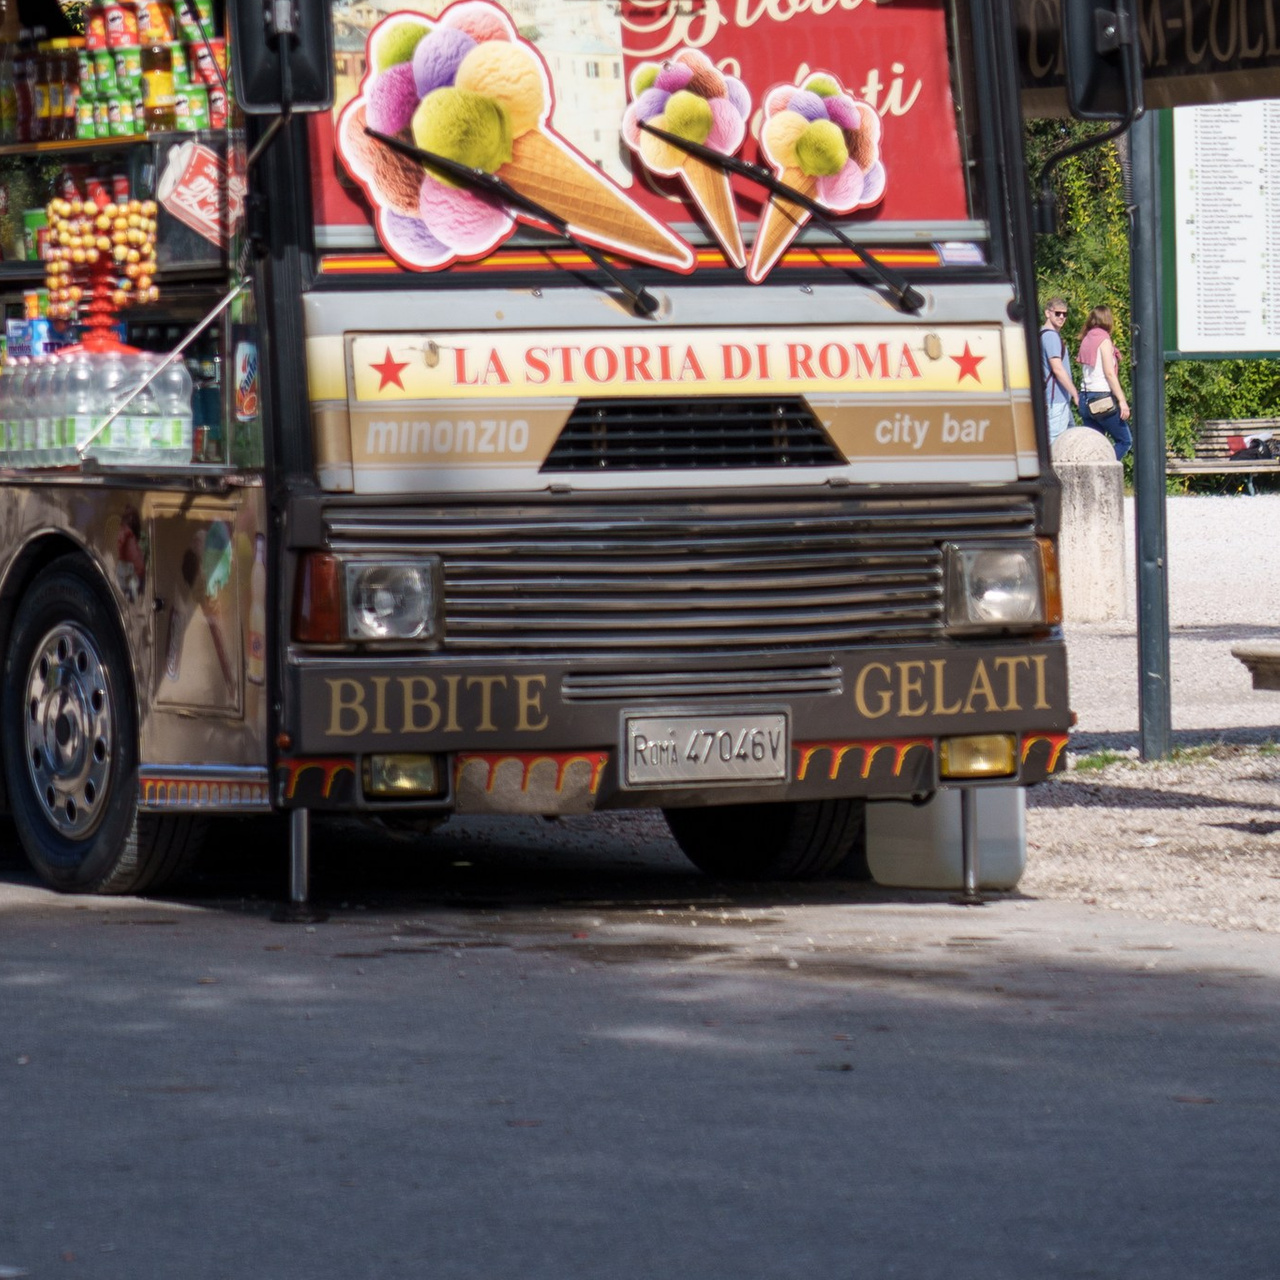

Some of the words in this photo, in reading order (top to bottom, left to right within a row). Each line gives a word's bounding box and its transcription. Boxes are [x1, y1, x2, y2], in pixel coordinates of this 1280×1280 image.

[453, 346, 512, 386] LA
[524, 343, 707, 385] STORIA
[721, 342, 771, 382] DI
[788, 340, 922, 381] ROMA
[365, 417, 530, 455] minonzio
[874, 413, 930, 451] city
[941, 410, 991, 444] bar
[325, 673, 549, 737] BIBITE
[854, 653, 1051, 719] GELATI
